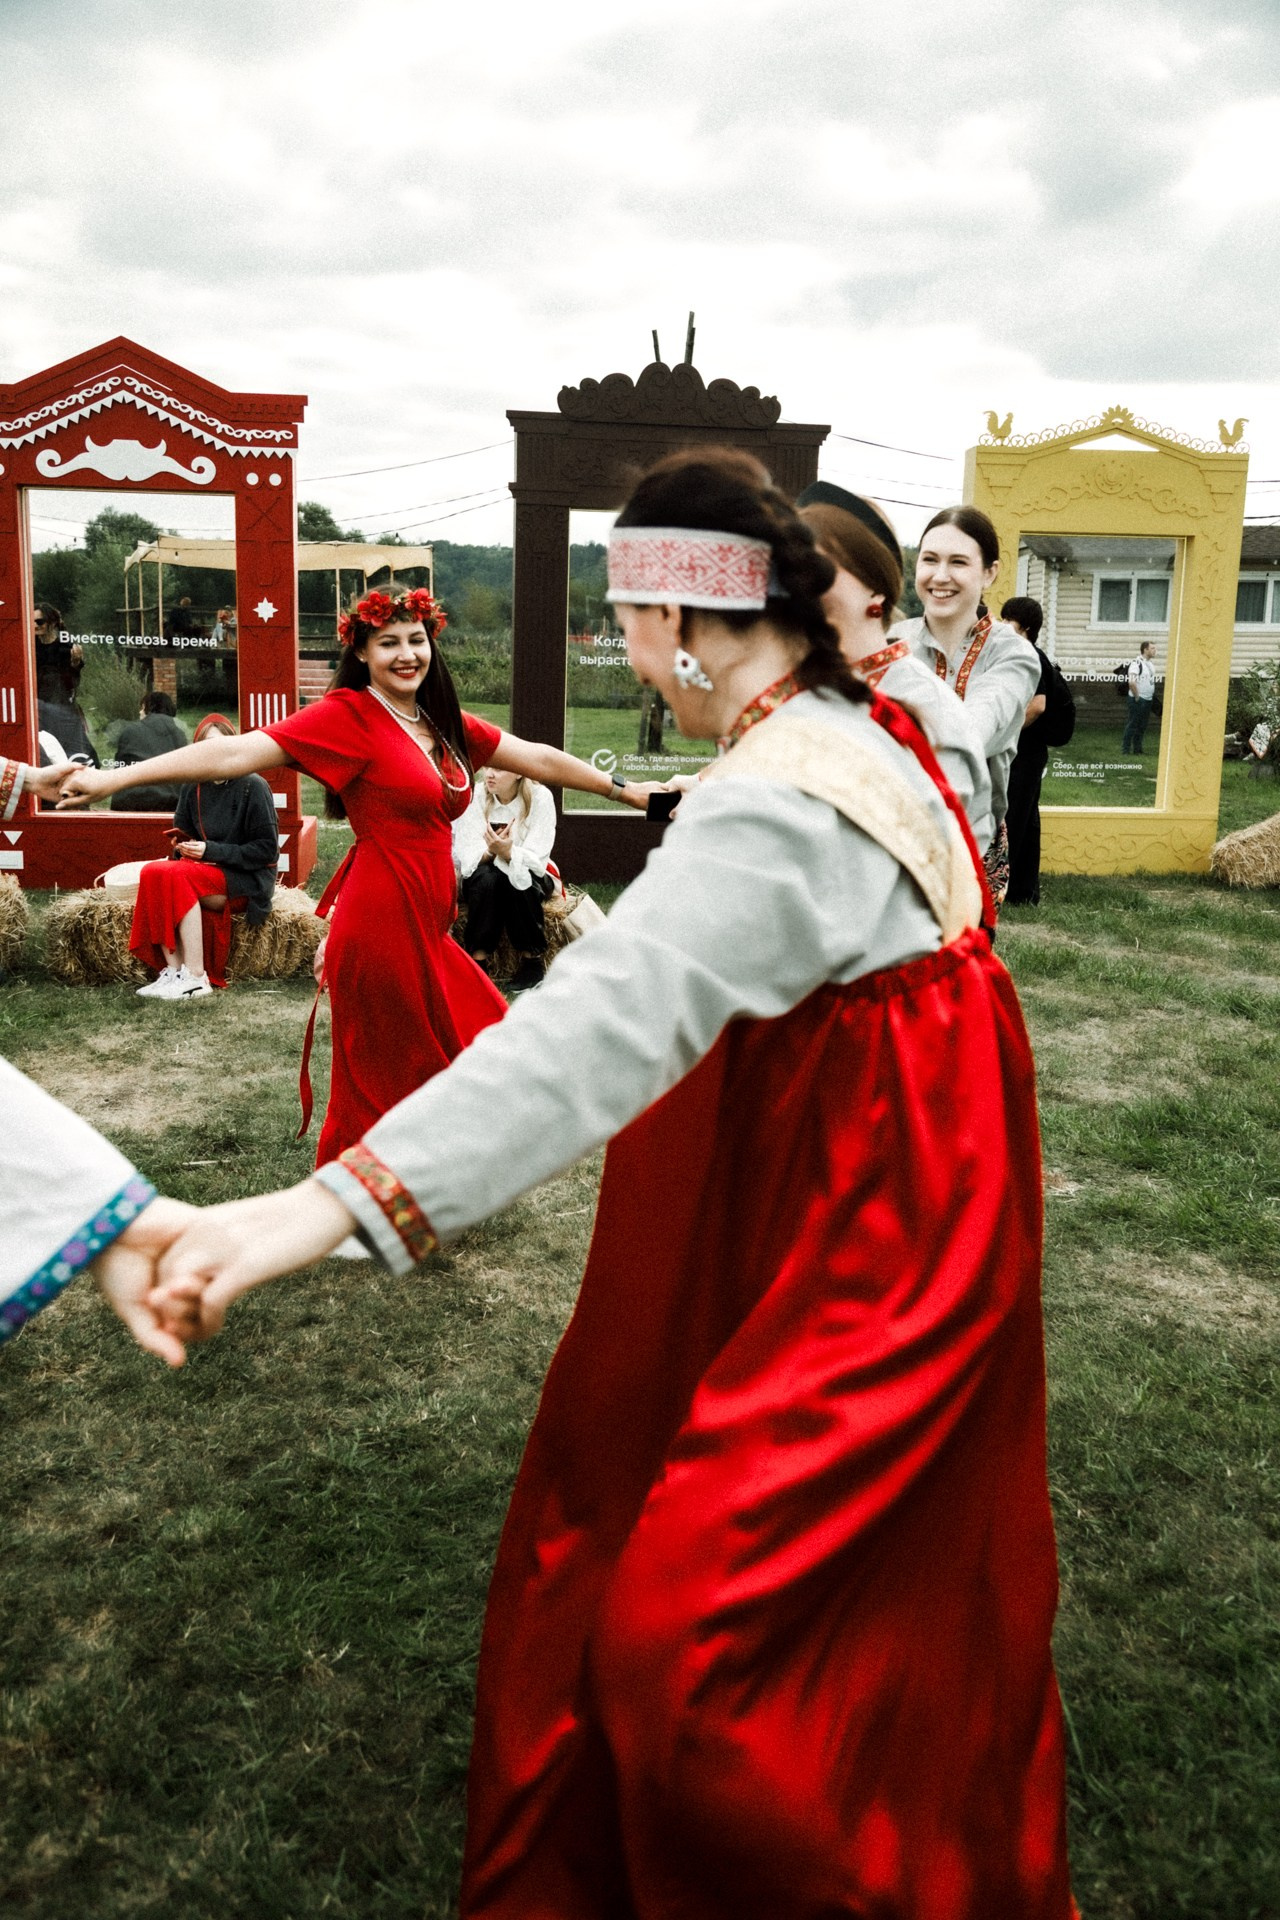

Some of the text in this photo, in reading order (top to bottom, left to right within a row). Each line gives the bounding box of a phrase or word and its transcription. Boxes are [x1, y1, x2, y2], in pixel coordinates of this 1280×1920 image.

[59, 630, 218, 649] Вместе сквозь время
[593, 635, 627, 649] Когд
[579, 655, 633, 667] выраста
[1085, 657, 1092, 665] в
[623, 754, 647, 763] Сбер,
[649, 755, 663, 763] где
[664, 754, 679, 763] всё
[622, 763, 681, 771] rabota.sber.ru
[1053, 762, 1075, 770] Сбер,
[1090, 762, 1104, 770] всё
[1052, 770, 1105, 778] rabota.sber.ru
